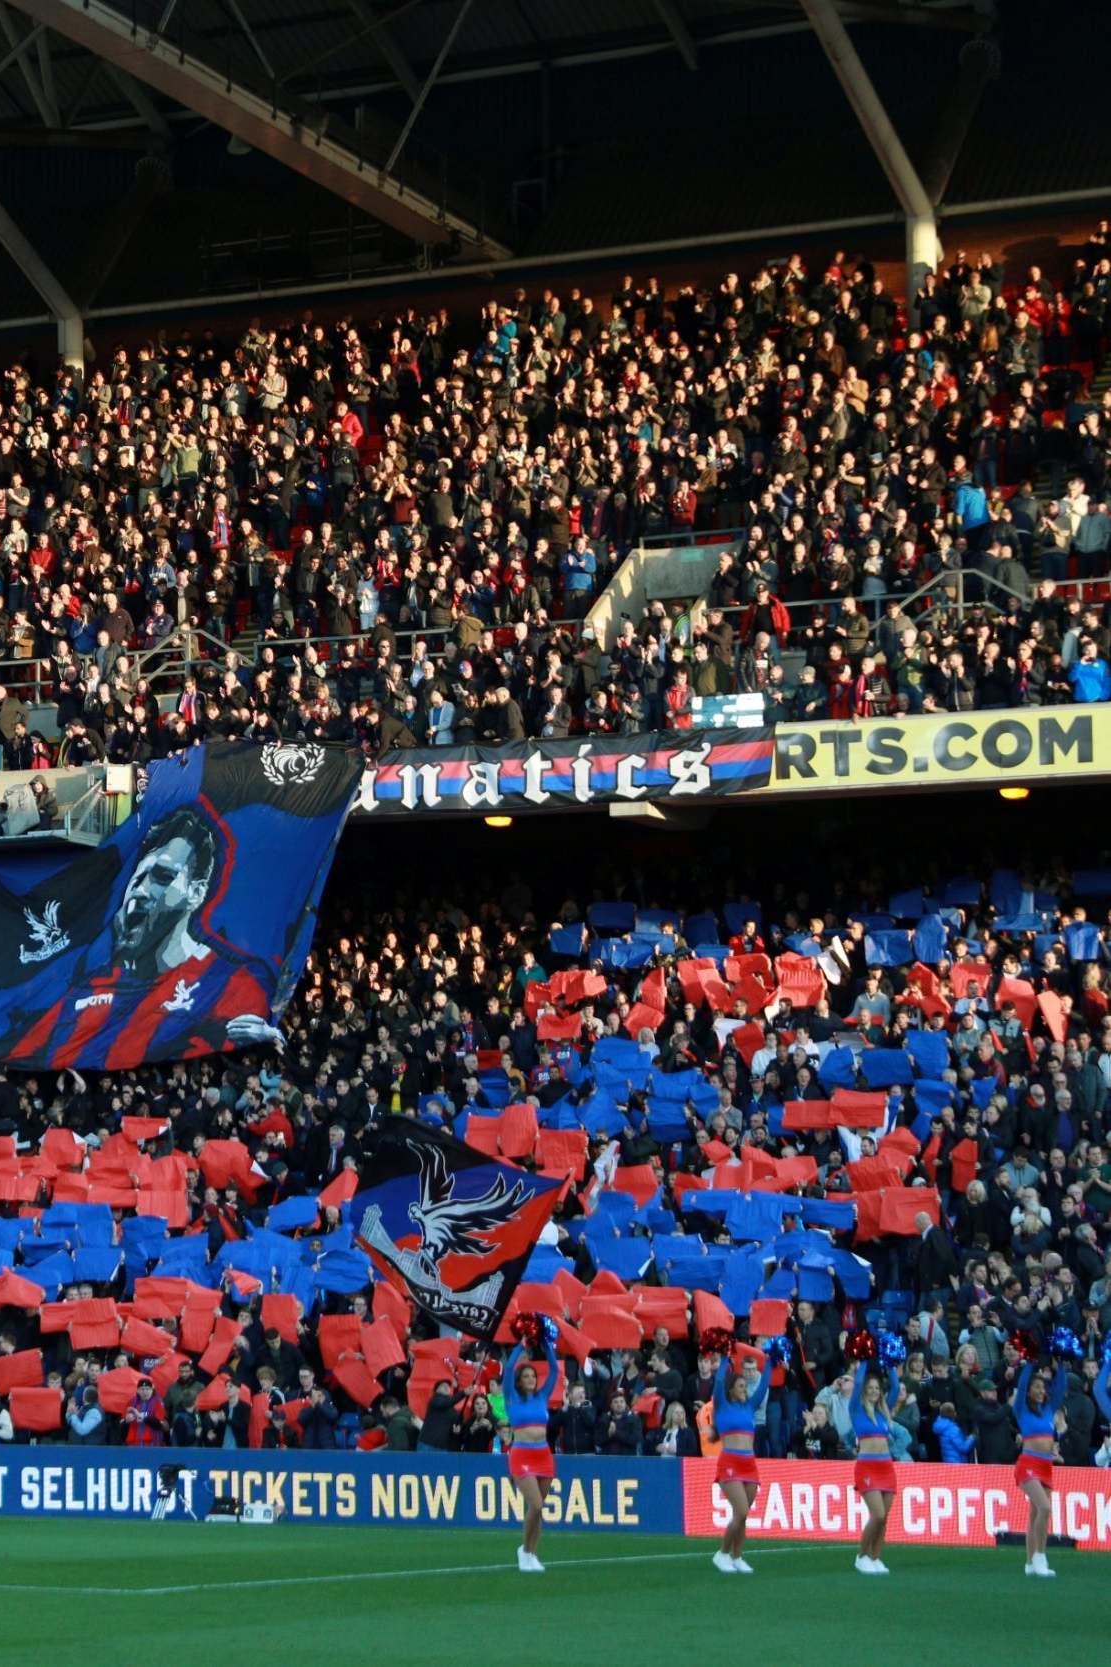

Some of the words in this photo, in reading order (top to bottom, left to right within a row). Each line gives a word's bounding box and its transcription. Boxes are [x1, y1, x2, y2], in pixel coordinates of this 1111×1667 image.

[209, 1470, 356, 1517] TICKETS
[372, 1474, 460, 1520] NOW
[475, 1476, 526, 1522] ON
[541, 1478, 639, 1525] SALE
[903, 1487, 1009, 1538] CPFC
[1025, 1490, 1111, 1543] ICK
